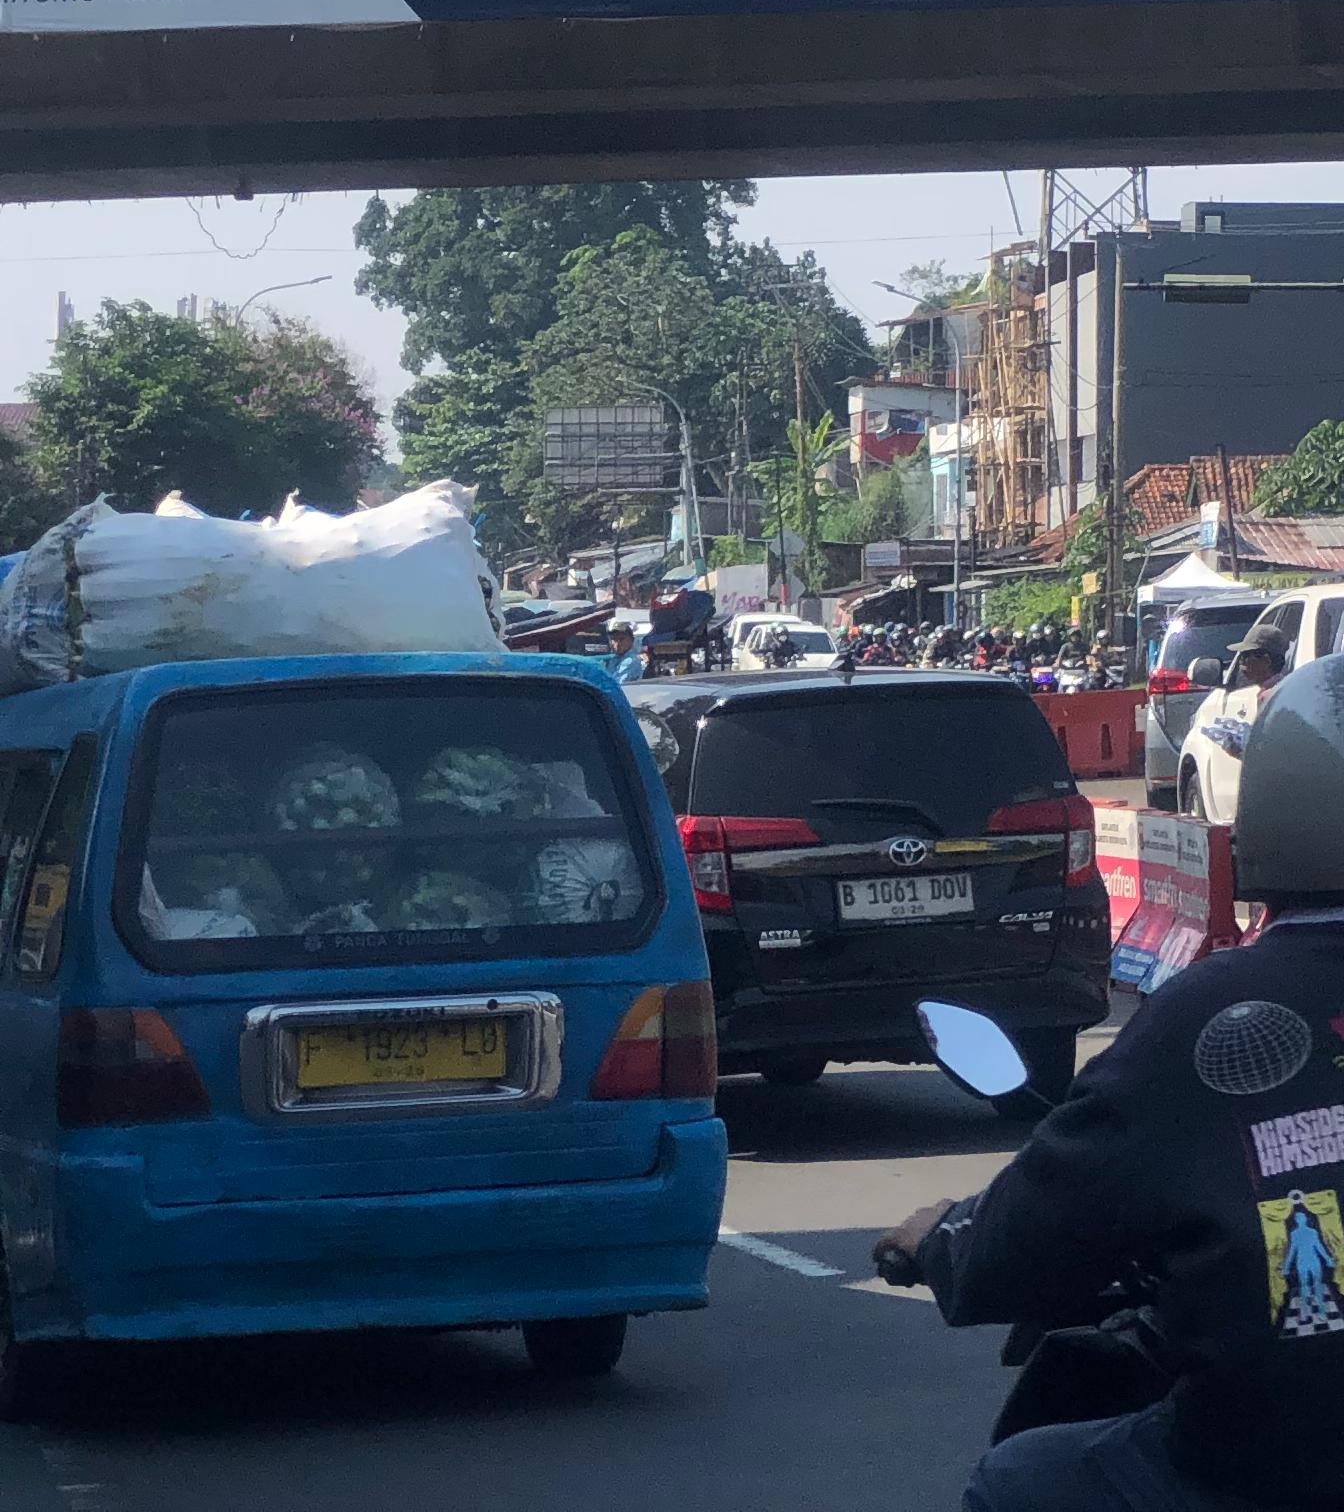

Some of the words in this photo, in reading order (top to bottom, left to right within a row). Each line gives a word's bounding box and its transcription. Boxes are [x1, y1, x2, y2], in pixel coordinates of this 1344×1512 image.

[842, 884, 855, 906] B
[867, 879, 919, 904] 1061
[929, 875, 967, 900] DOV
